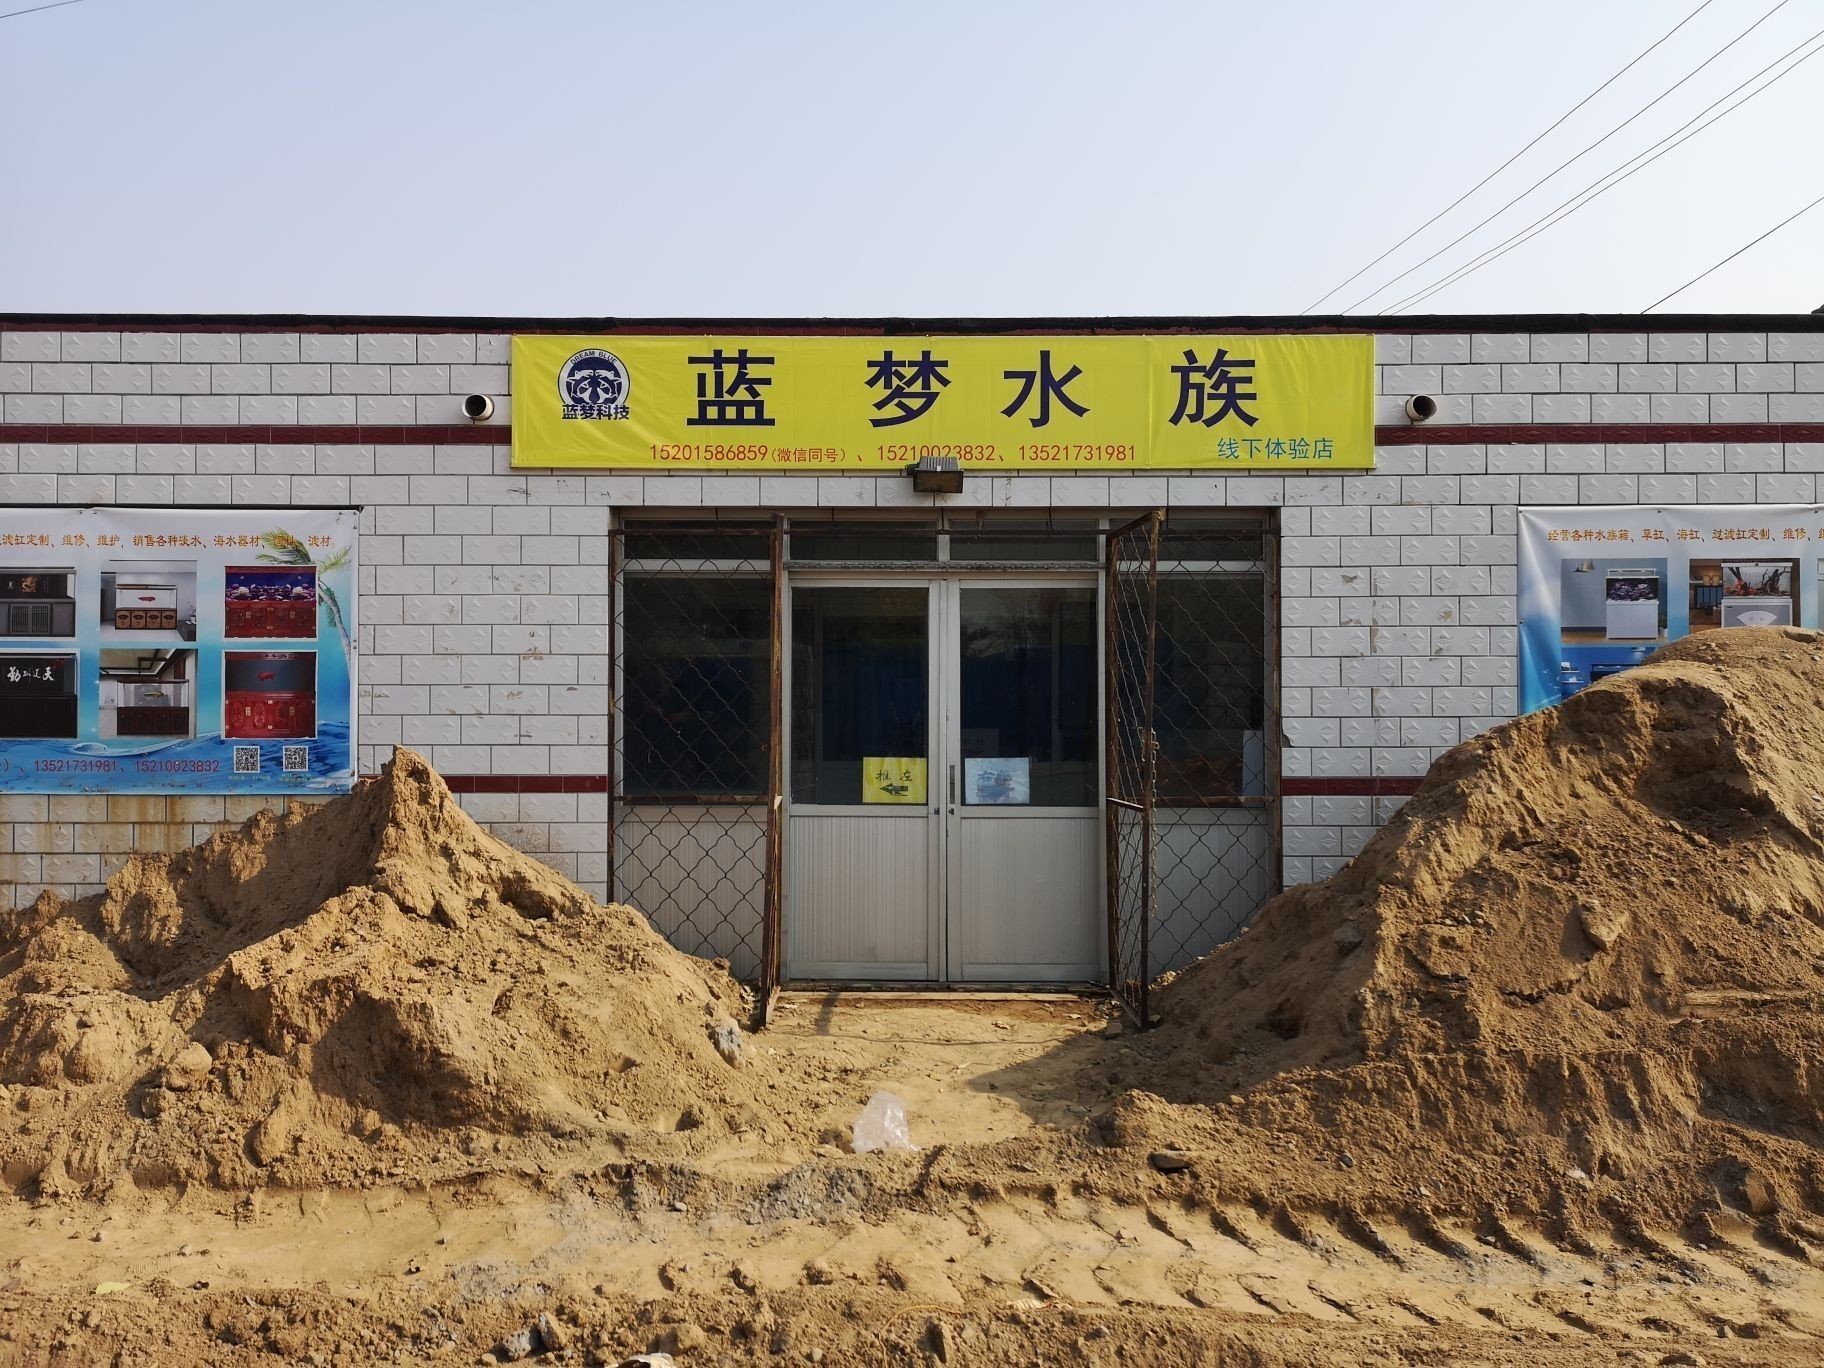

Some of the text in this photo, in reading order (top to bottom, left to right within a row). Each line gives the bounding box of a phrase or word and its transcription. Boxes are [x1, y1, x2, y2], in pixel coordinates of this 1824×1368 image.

[570, 350, 618, 365] DREAM BLUE
[687, 348, 1259, 427] 蓝梦水族
[562, 403, 630, 420] 蓝梦科技
[1217, 437, 1334, 460] 线下体验店
